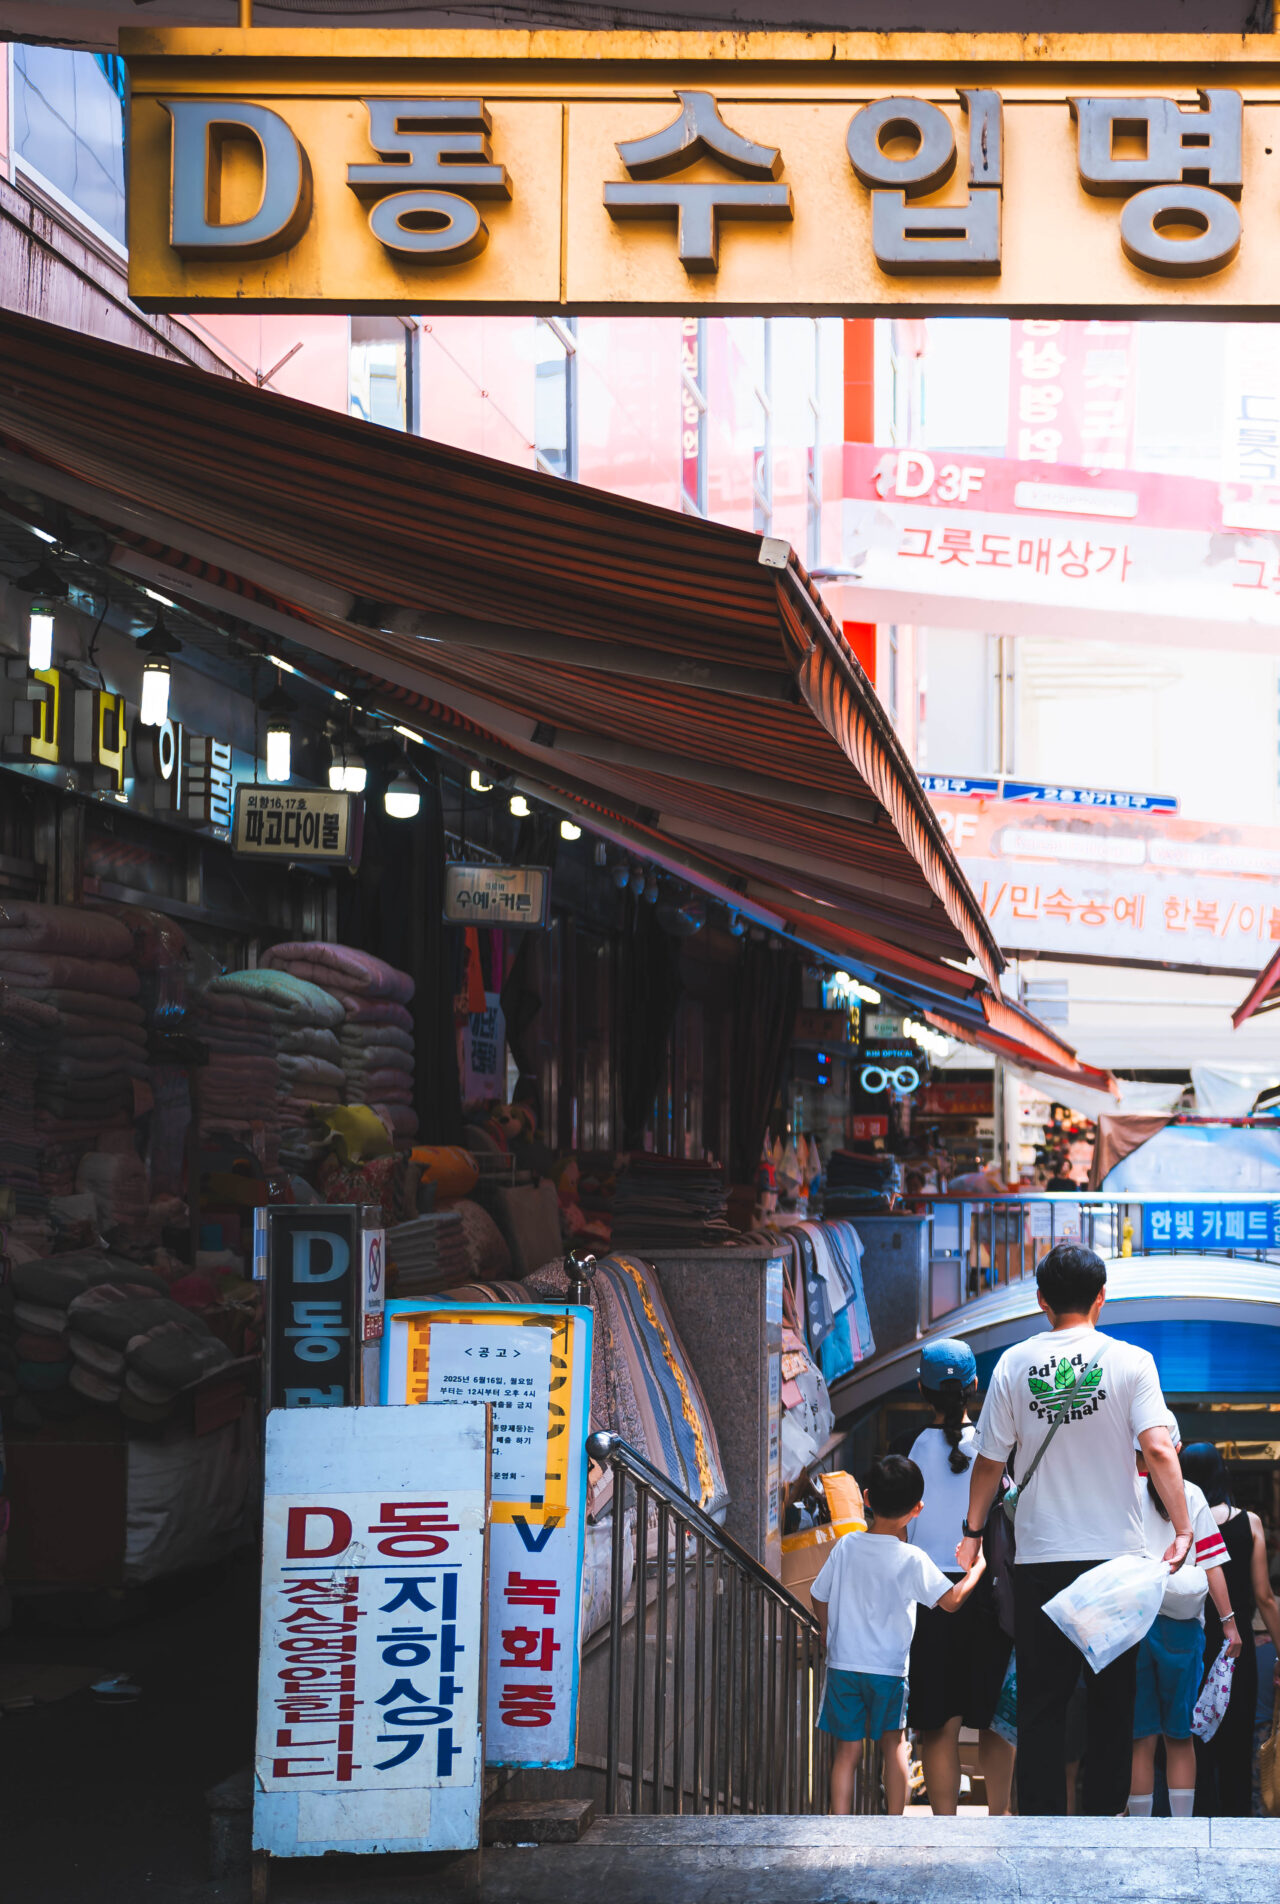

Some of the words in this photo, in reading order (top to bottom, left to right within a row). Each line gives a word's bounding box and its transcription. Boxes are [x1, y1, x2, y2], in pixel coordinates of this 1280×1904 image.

[895, 450, 935, 498] D
[937, 464, 986, 502] 3F
[897, 526, 1133, 584] 그릇도매상가
[245, 809, 340, 850] 파고다이불
[882, 1049, 914, 1058] OPTICAL
[1151, 1209, 1194, 1240] 한빛
[1201, 1210, 1268, 1240] 카페트
[440, 1387, 463, 1395] 부터는
[468, 1388, 500, 1397] 12시부터
[504, 1389, 520, 1398] 오후
[523, 1390, 536, 1398] 4시
[443, 1375, 470, 1384] 2025년
[286, 1501, 460, 1560] D동
[373, 1572, 465, 1777] 지하상가
[499, 1571, 561, 1728] 녹화중
[272, 1577, 368, 1782] 정상영업합니다
